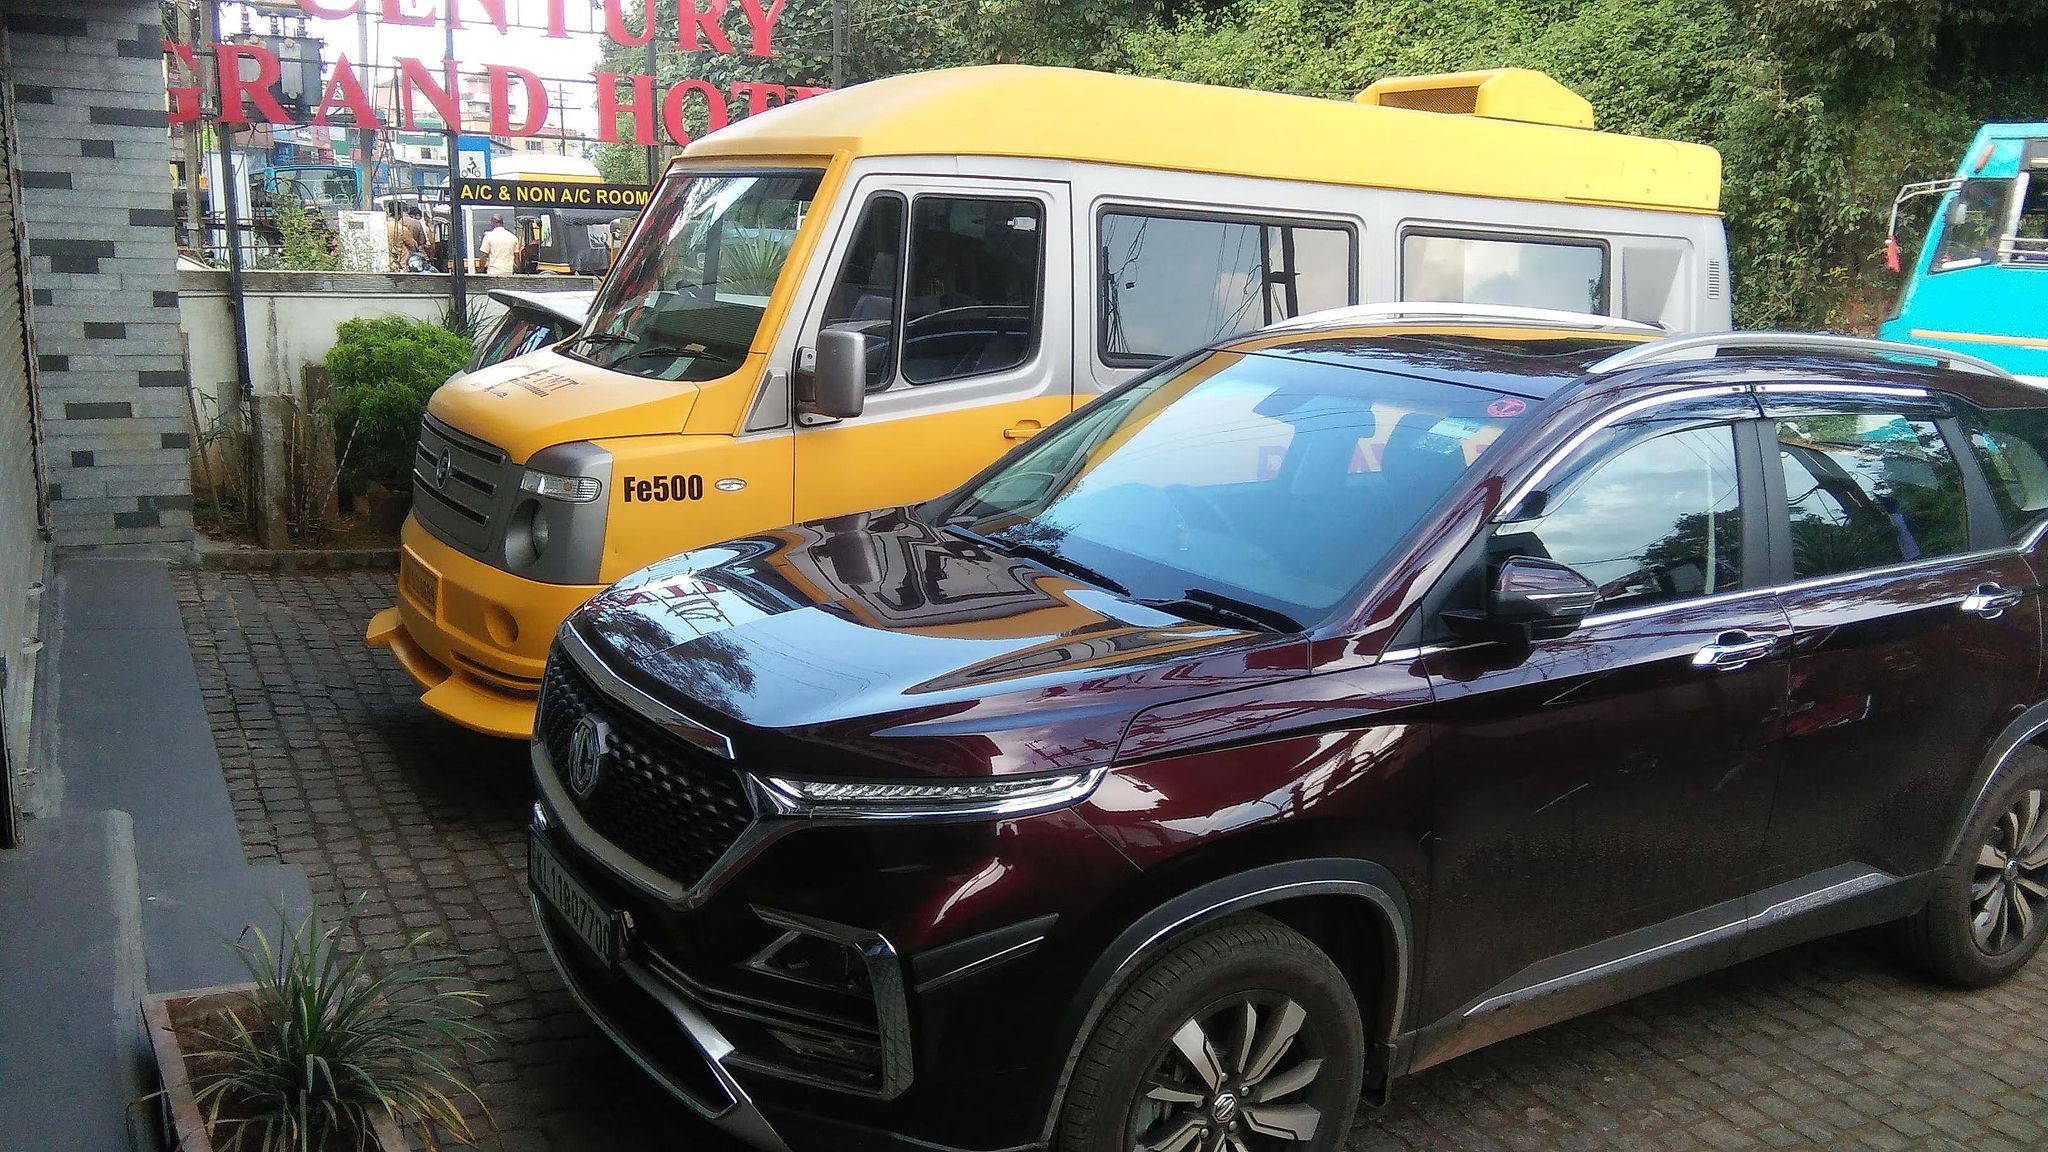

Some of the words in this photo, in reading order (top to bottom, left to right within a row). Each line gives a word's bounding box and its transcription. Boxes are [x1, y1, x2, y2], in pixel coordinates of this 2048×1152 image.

[295, 0, 786, 58] TURY
[590, 71, 836, 147] HOT
[460, 184, 492, 200] A/C
[498, 185, 511, 201] &
[516, 186, 556, 203] NON
[560, 188, 591, 204] A/C
[596, 189, 652, 206] ROOM
[624, 475, 703, 502] Fe500
